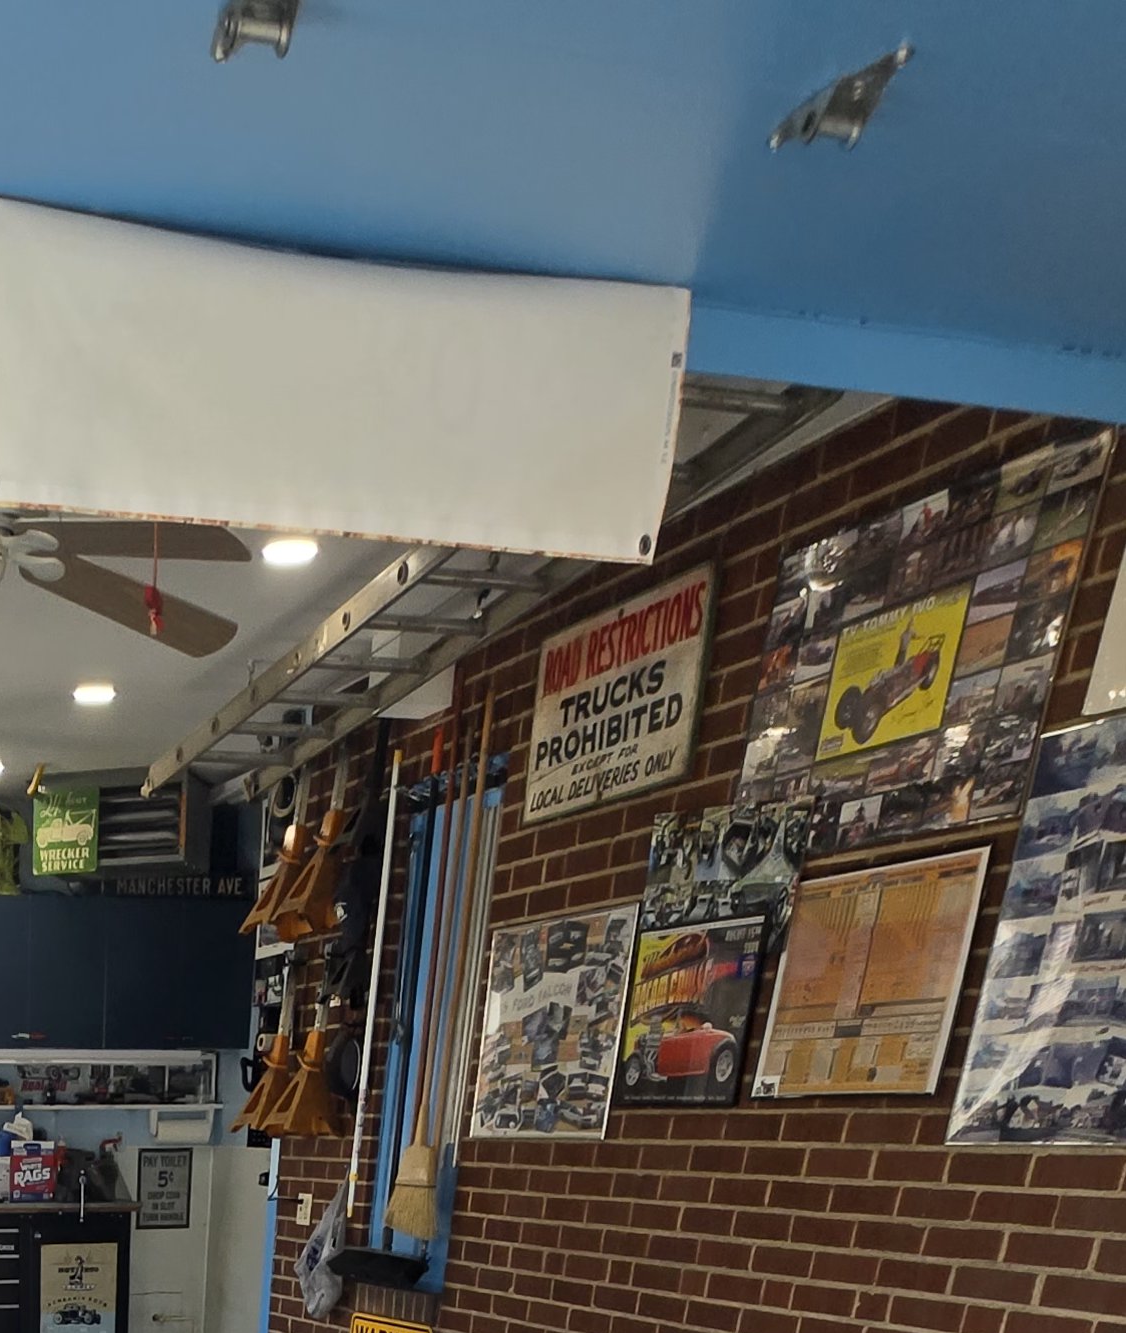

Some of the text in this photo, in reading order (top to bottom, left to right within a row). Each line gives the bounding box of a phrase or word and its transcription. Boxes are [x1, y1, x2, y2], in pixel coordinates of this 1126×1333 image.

[863, 605, 909, 631] TOMMY
[543, 581, 706, 697] ROAD RESTRICTIONS
[560, 659, 667, 728] TRUCKS
[534, 692, 683, 772] PROHIBITED
[571, 743, 638, 776] EXCEPT FOR
[530, 746, 678, 813] LOCAL DELIVERIES ONLY
[39, 847, 90, 861] WRECKER
[41, 859, 85, 873] SERVICE
[116, 877, 243, 895] MANCHESTER AVE
[14, 1167, 51, 1188] RAGS
